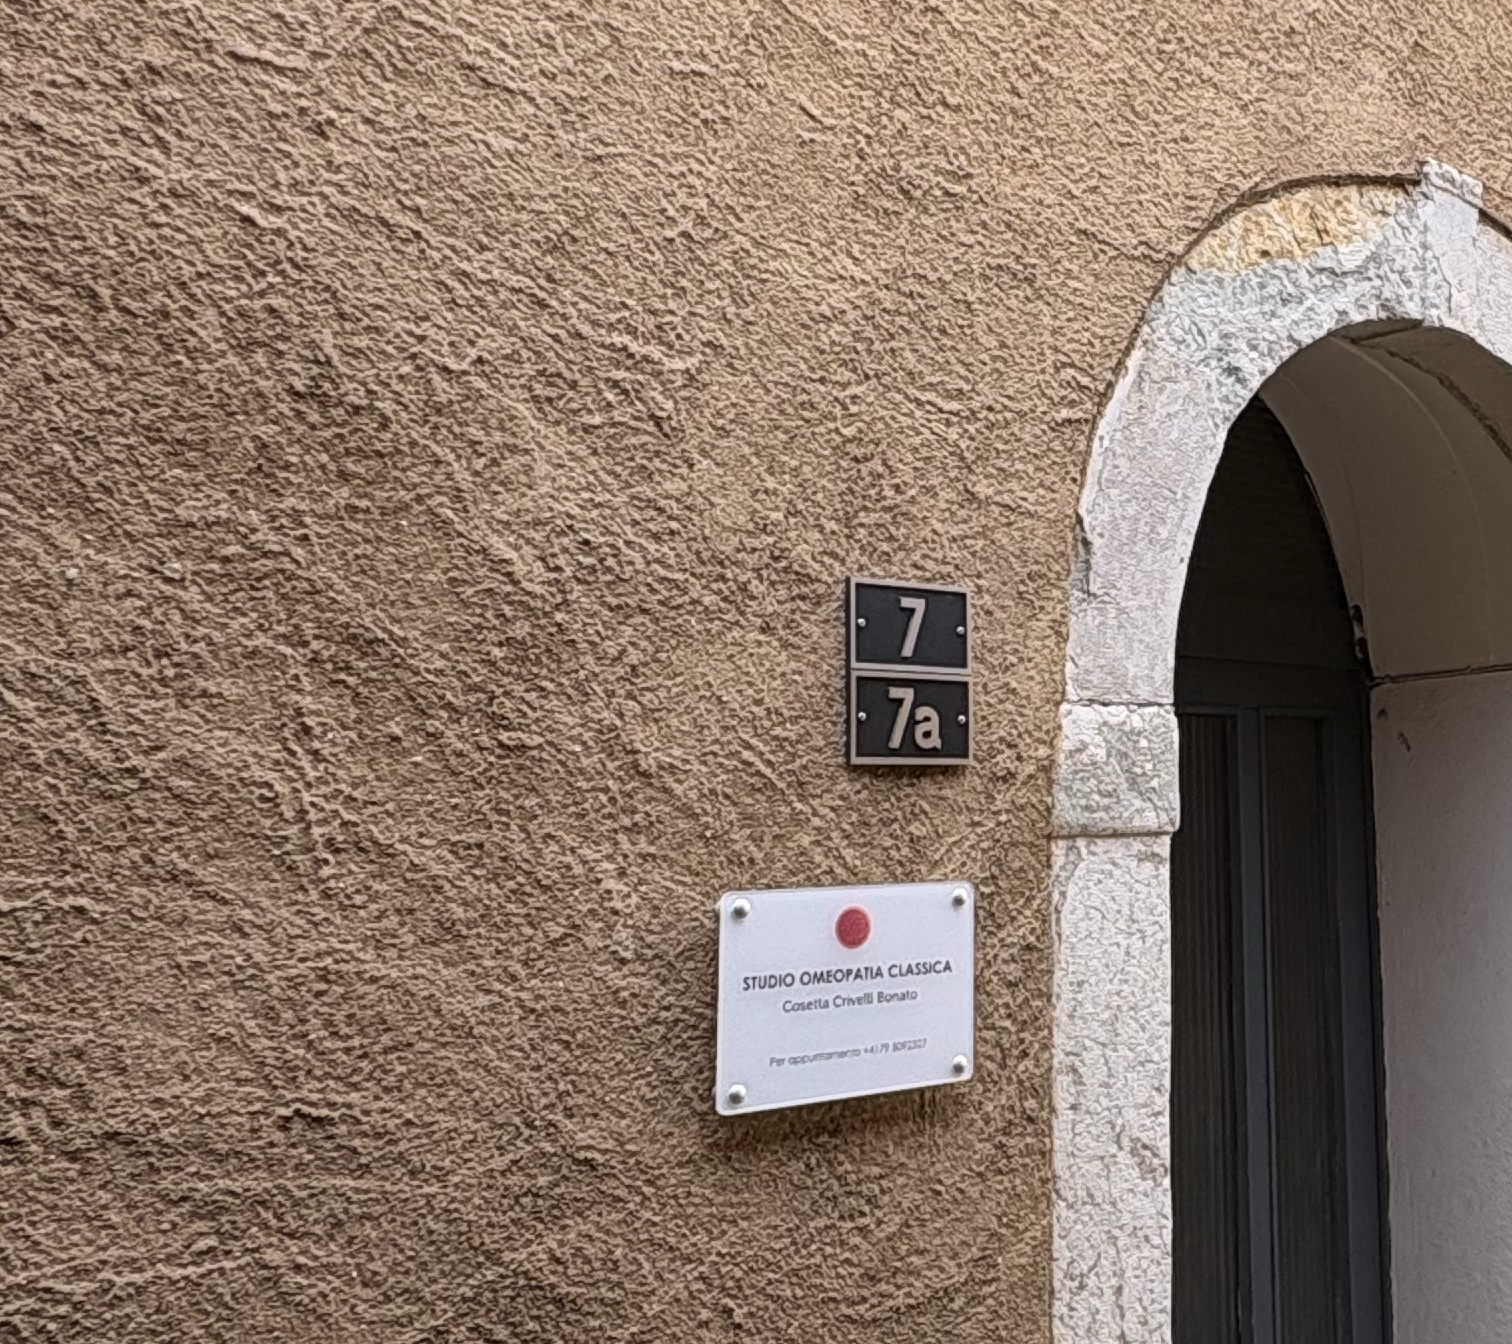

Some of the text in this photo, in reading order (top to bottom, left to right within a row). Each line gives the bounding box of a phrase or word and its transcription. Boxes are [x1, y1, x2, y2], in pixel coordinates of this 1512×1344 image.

[900, 596, 926, 658] 7
[887, 686, 942, 750] 7a
[743, 960, 952, 991] STUDIO OMEOPATIA CLASSICA
[833, 991, 873, 1008] Crivelli
[877, 989, 918, 1003] Bonato
[769, 1056, 785, 1067] Per
